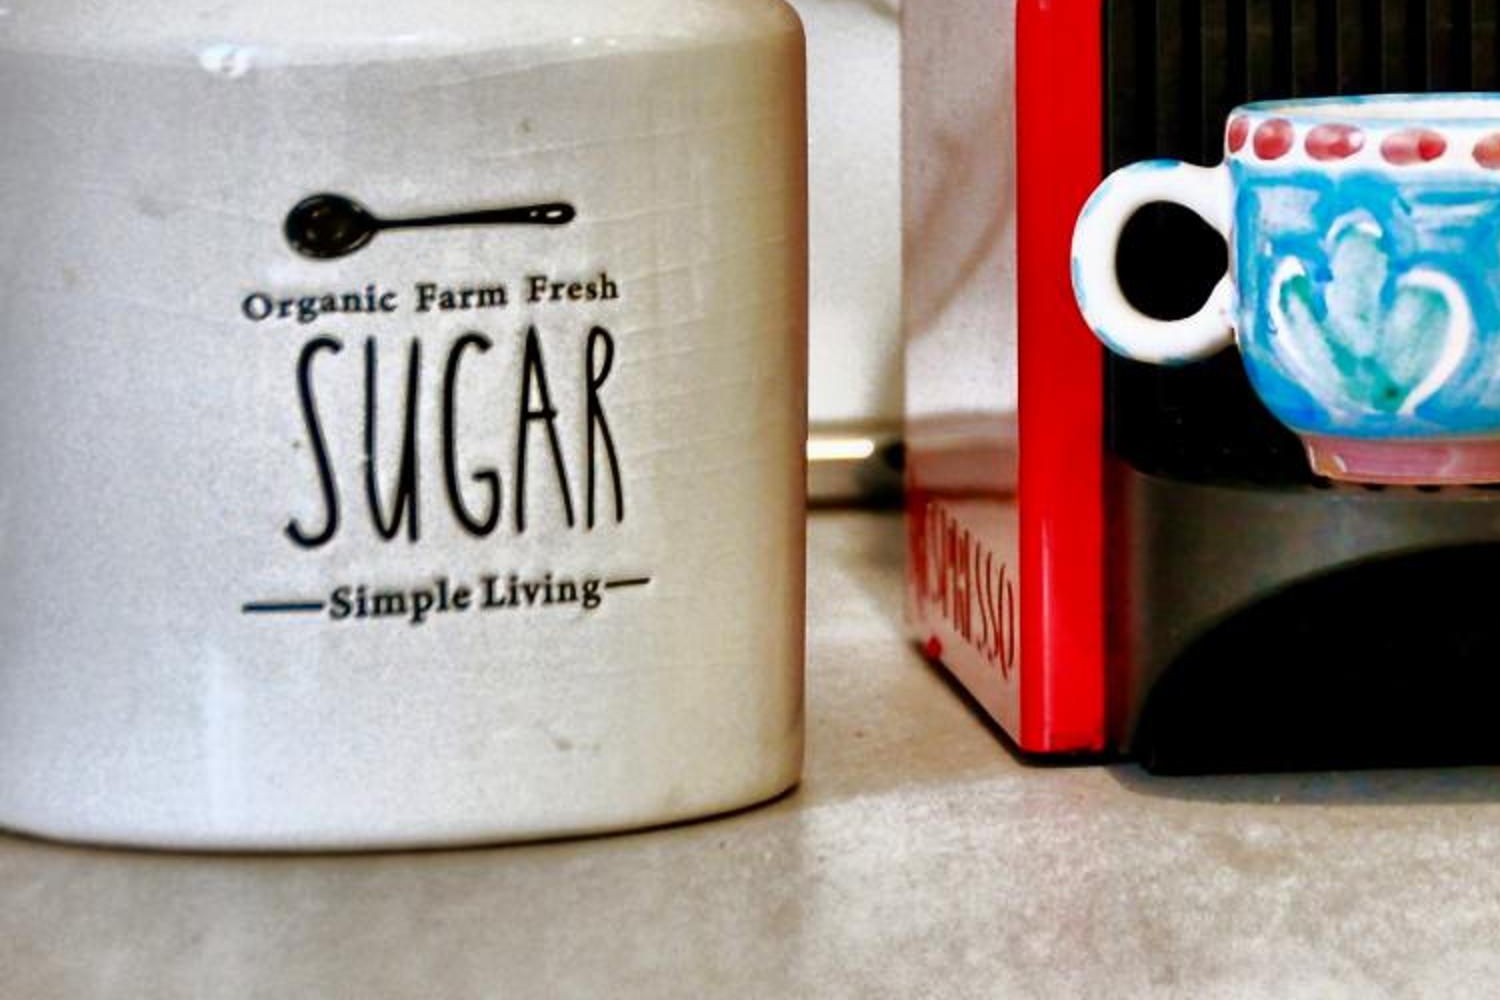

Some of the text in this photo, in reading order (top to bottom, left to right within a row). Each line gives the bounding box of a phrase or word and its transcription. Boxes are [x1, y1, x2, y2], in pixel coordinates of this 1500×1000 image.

[242, 273, 620, 323] Organic Farm Fresh
[285, 325, 624, 549] SUGAR
[329, 573, 602, 625] Simple Living
